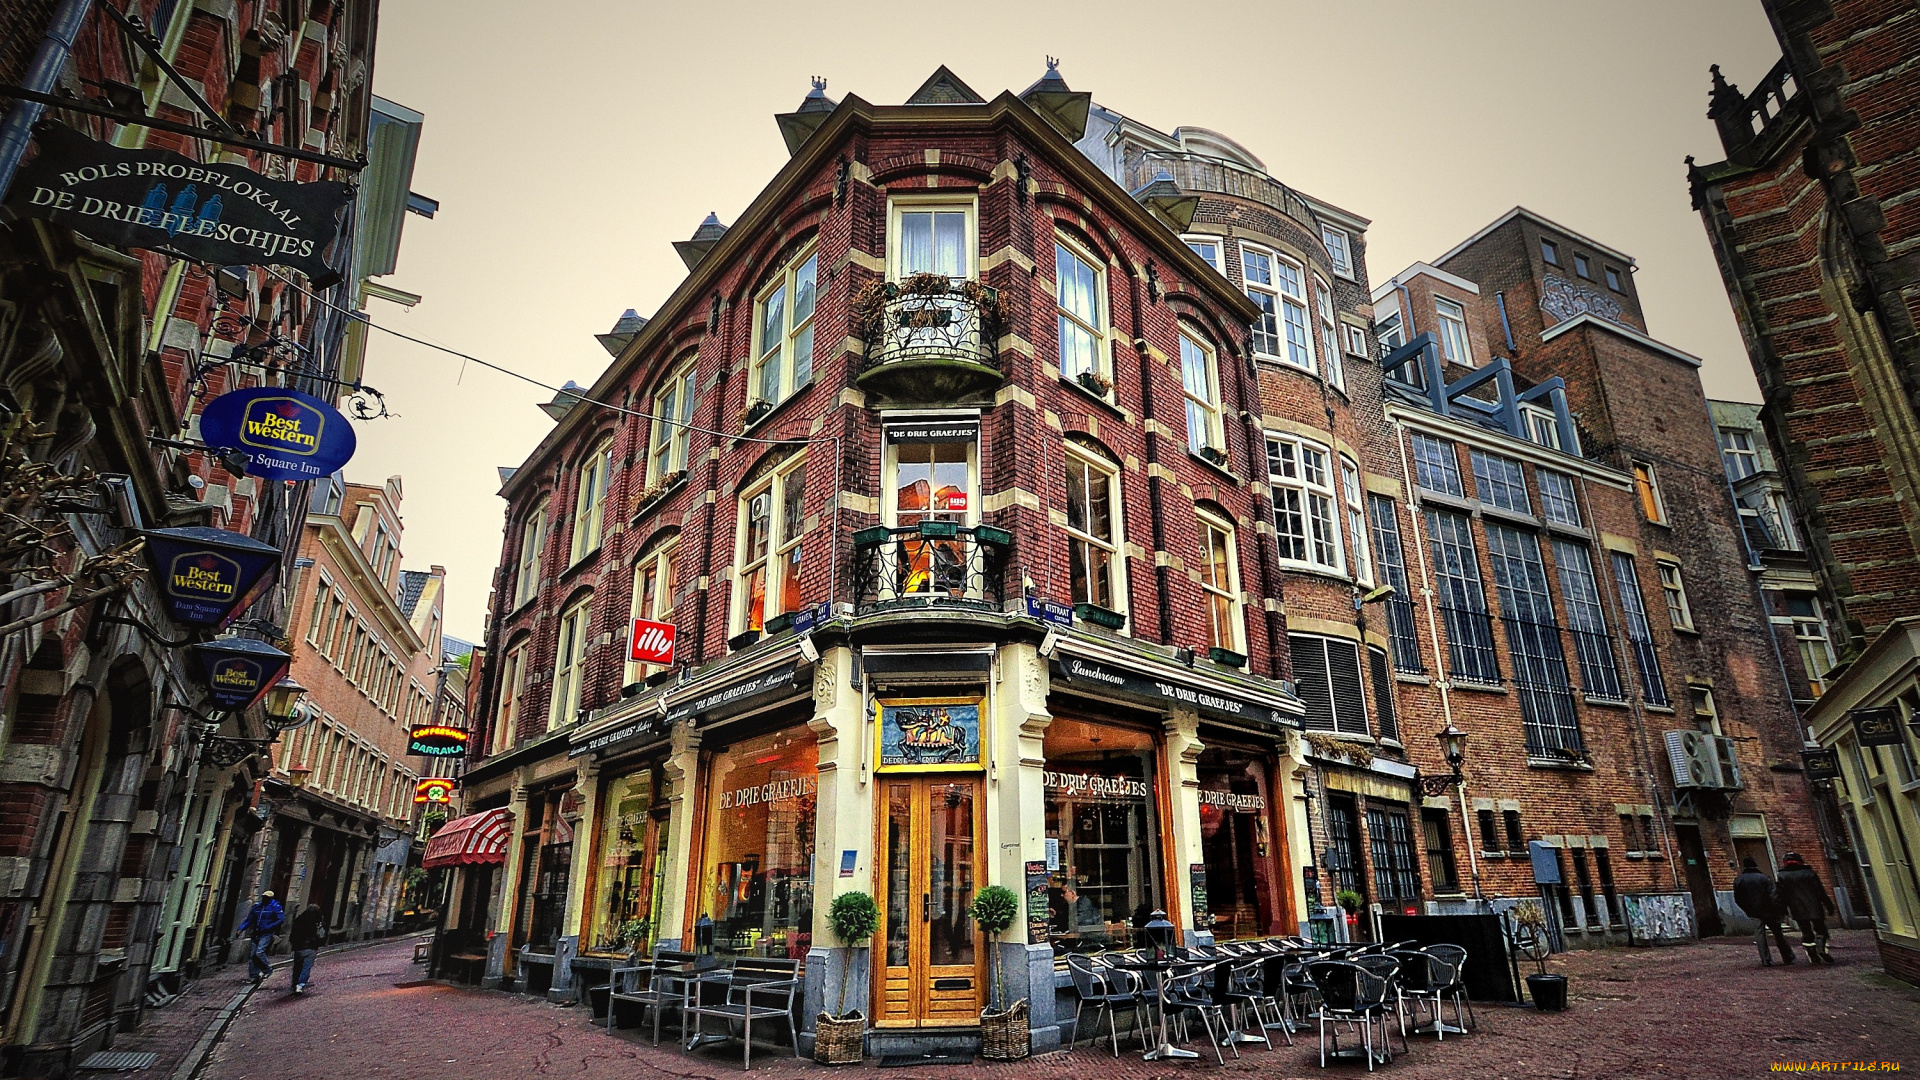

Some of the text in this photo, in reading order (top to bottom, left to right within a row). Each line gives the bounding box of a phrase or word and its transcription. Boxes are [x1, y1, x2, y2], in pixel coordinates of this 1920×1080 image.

[60, 161, 302, 231] BOLS PROEFLOKAAL
[29, 186, 315, 258] DE DRIE FLESCHJES
[264, 412, 302, 432] Best
[248, 420, 315, 446] Western
[256, 453, 298, 471] Square
[301, 461, 320, 475] Inn
[188, 566, 221, 582] Best
[174, 575, 233, 594] Western
[175, 601, 221, 615] Dam Square
[189, 612, 203, 620] Inn
[637, 627, 673, 658] illy
[215, 674, 256, 687] Western
[225, 668, 248, 678] Best
[706, 693, 723, 706] DRIE
[1071, 660, 1125, 685] Lunchroom
[1176, 687, 1198, 702] DRIE
[1271, 710, 1300, 727] Brasserie
[413, 727, 467, 740] COFFEESHOP
[411, 741, 464, 755] BARRAKA
[719, 775, 816, 810] DE DRIE GRAEFJES
[1058, 773, 1087, 796] DRIE
[1089, 777, 1147, 798] GRAEFJES
[1204, 790, 1225, 809] DRIE
[1226, 793, 1265, 812] GRAEFJES
